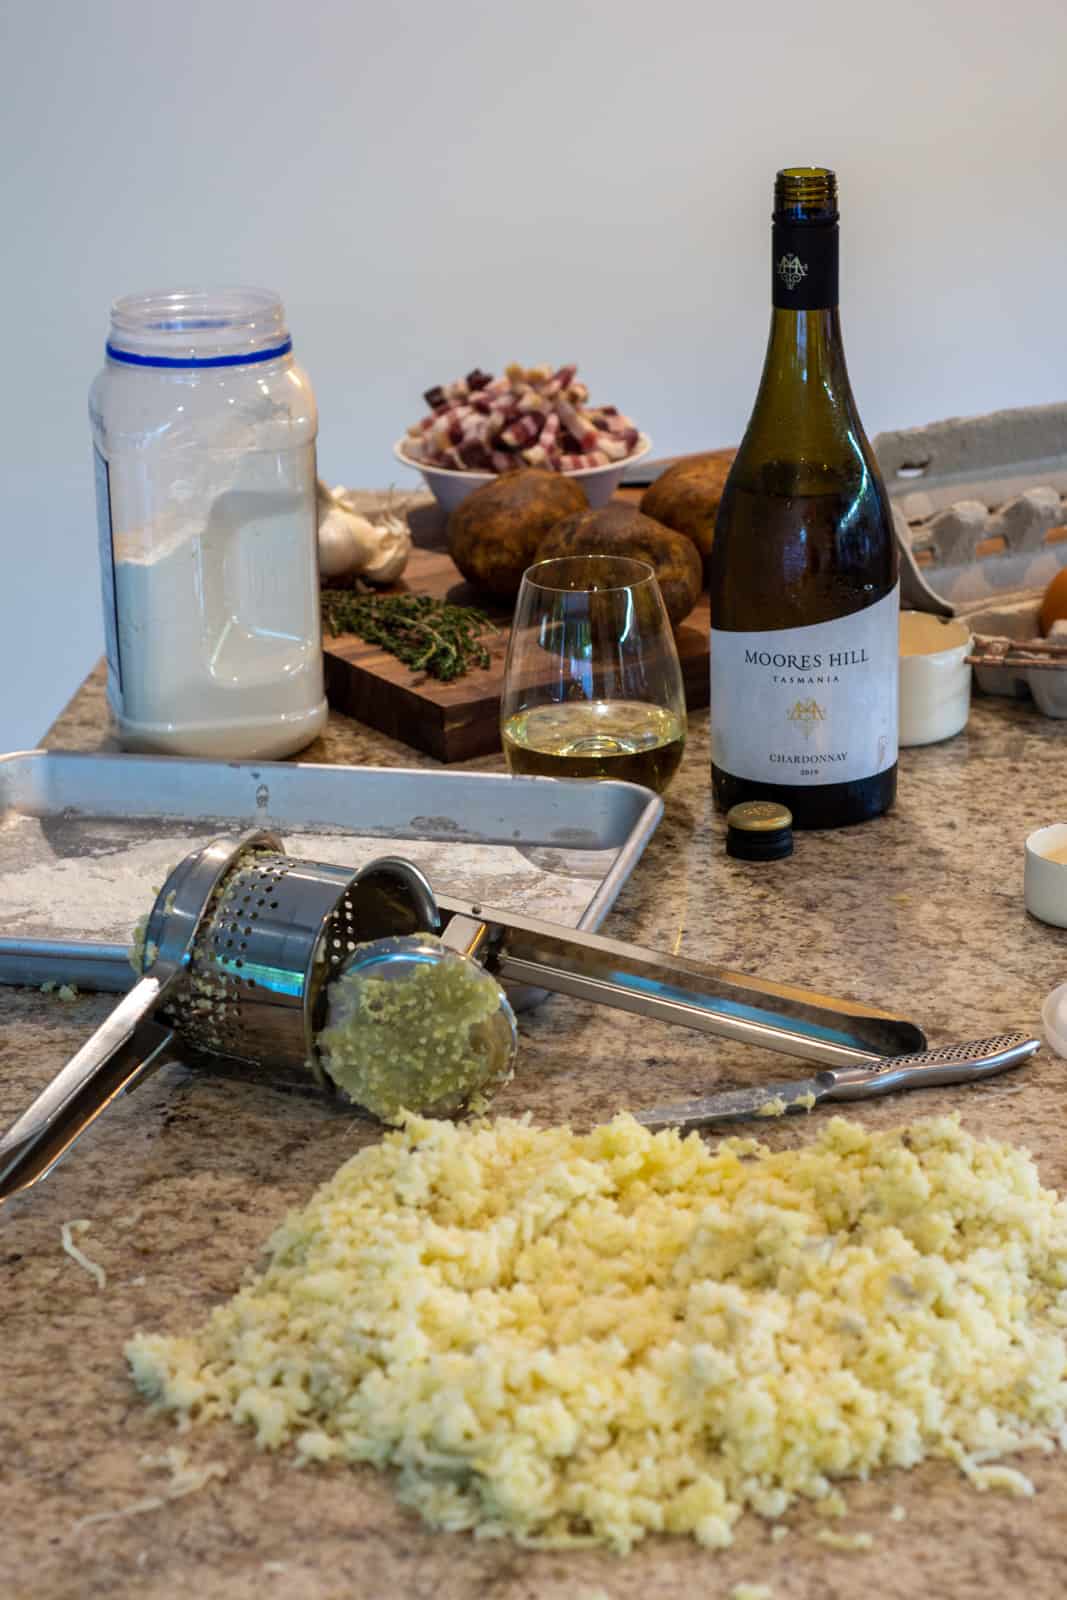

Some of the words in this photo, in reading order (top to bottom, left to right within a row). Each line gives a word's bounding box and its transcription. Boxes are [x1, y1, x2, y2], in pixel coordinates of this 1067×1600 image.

[744, 649, 822, 671] MOORES
[829, 649, 870, 667] HILL
[773, 675, 839, 684] TASMANIA
[769, 752, 848, 764] CHARDONNAY
